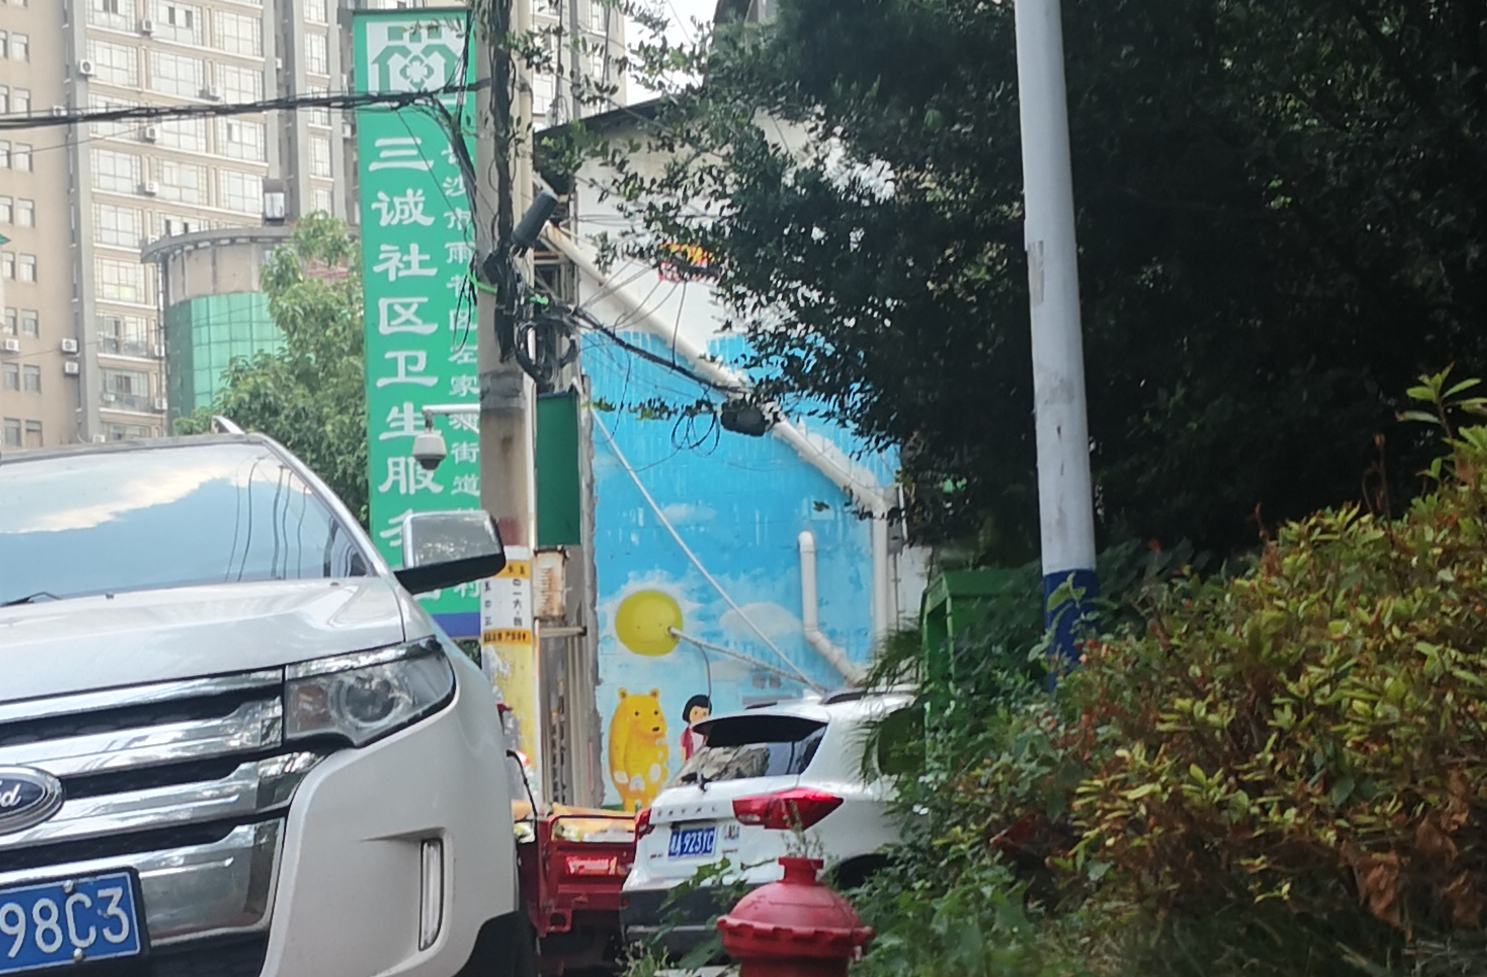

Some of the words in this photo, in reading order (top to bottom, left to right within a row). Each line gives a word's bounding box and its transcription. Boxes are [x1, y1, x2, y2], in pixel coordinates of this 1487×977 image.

[369, 138, 445, 601] 三诚社区卫生服
